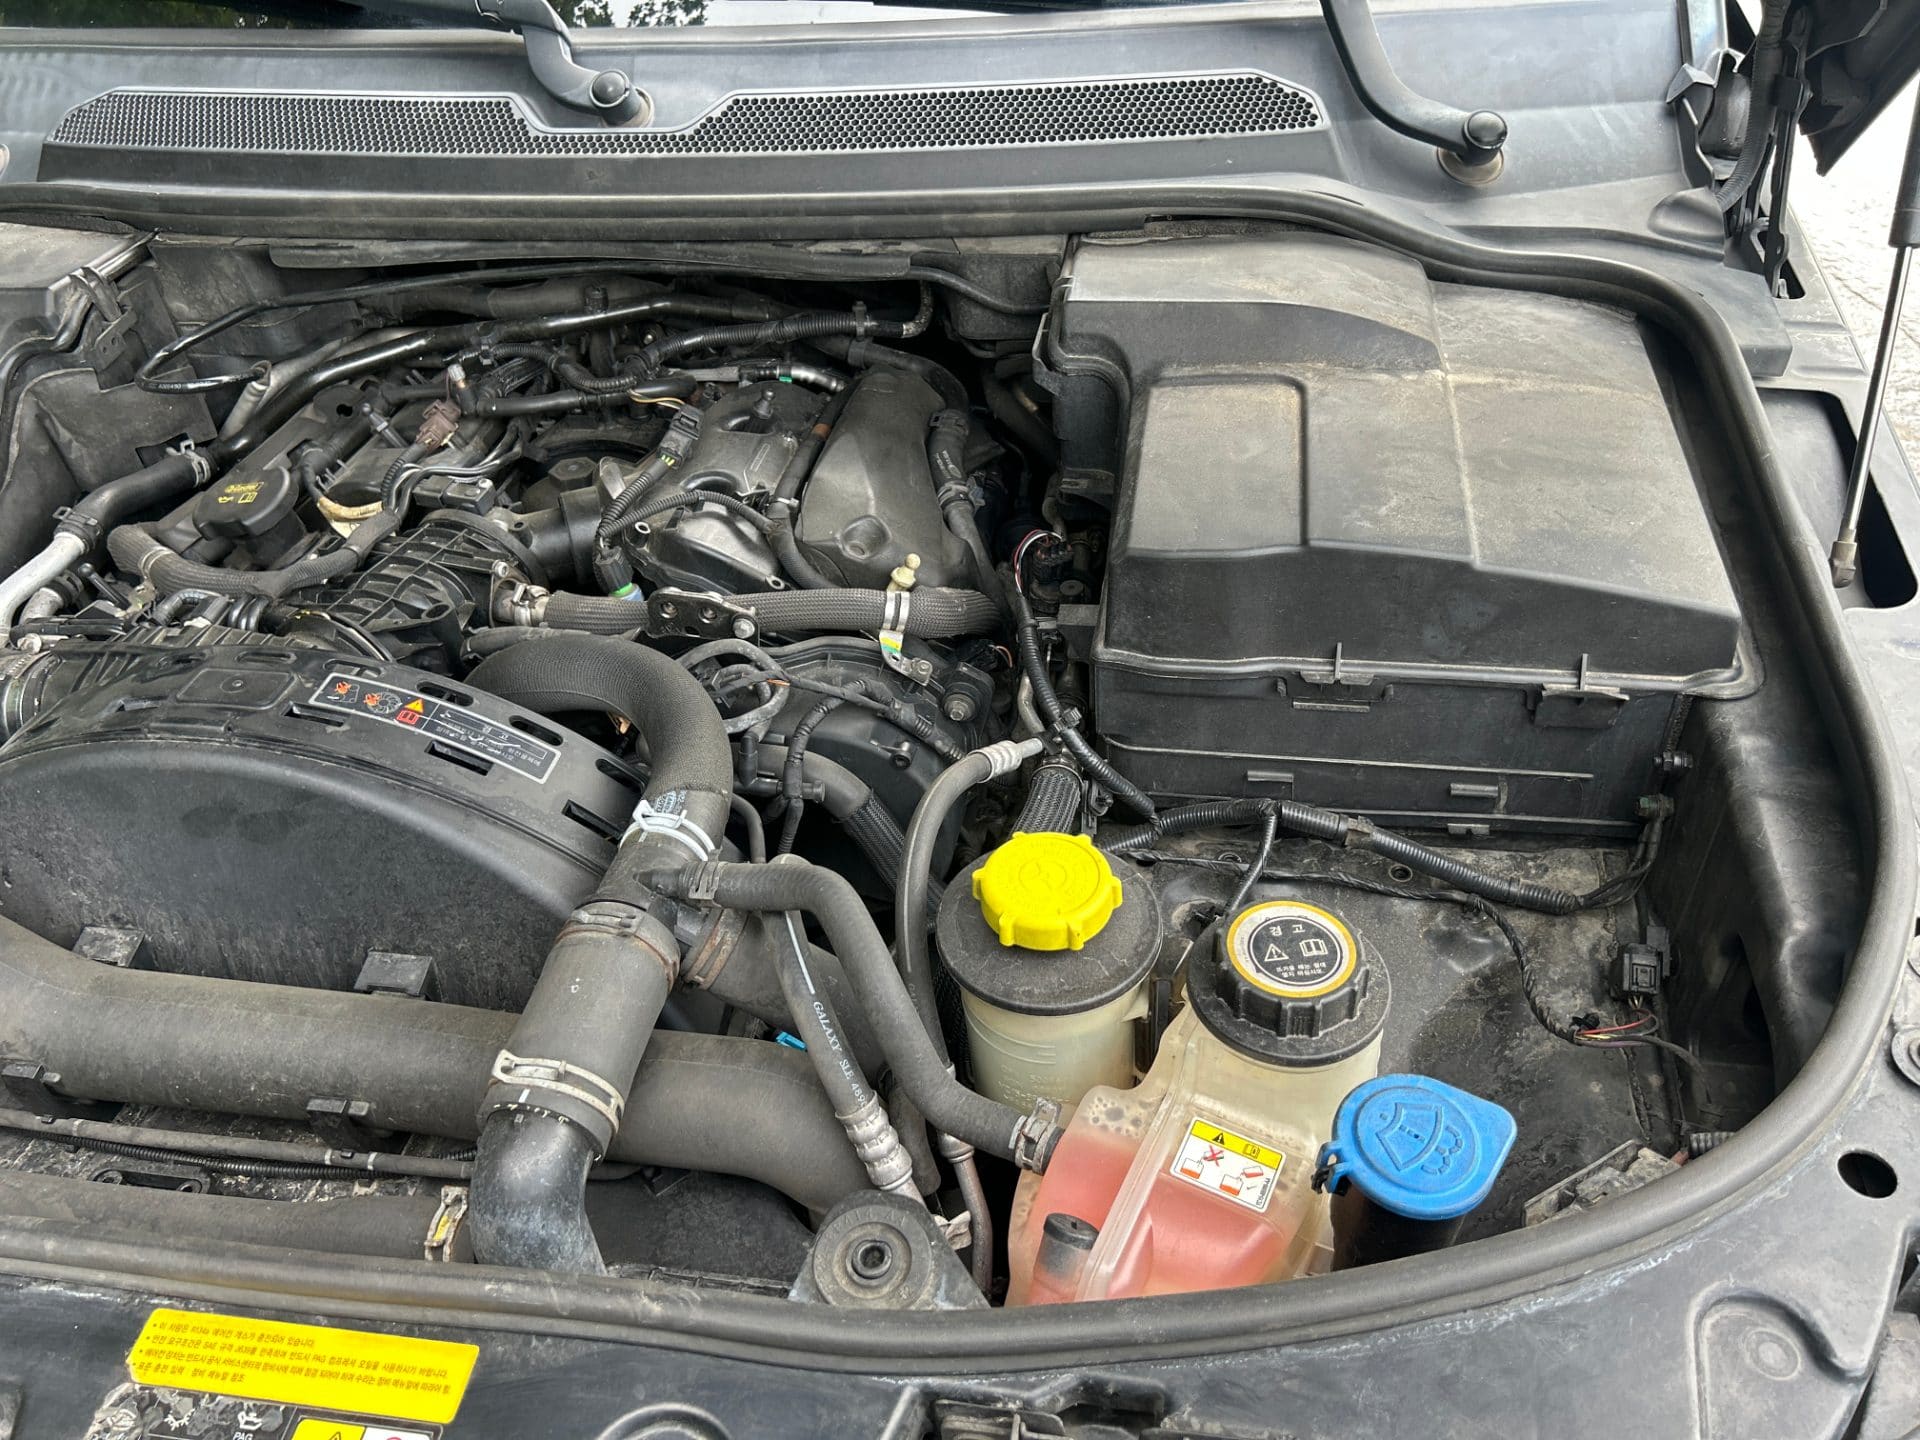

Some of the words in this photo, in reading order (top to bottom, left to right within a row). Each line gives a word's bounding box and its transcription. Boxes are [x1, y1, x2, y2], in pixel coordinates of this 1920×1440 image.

[1269, 925, 1282, 936] 경
[1292, 924, 1305, 933] 고
[813, 1001, 842, 1052] GALAXY
[840, 1059, 855, 1080] SLE
